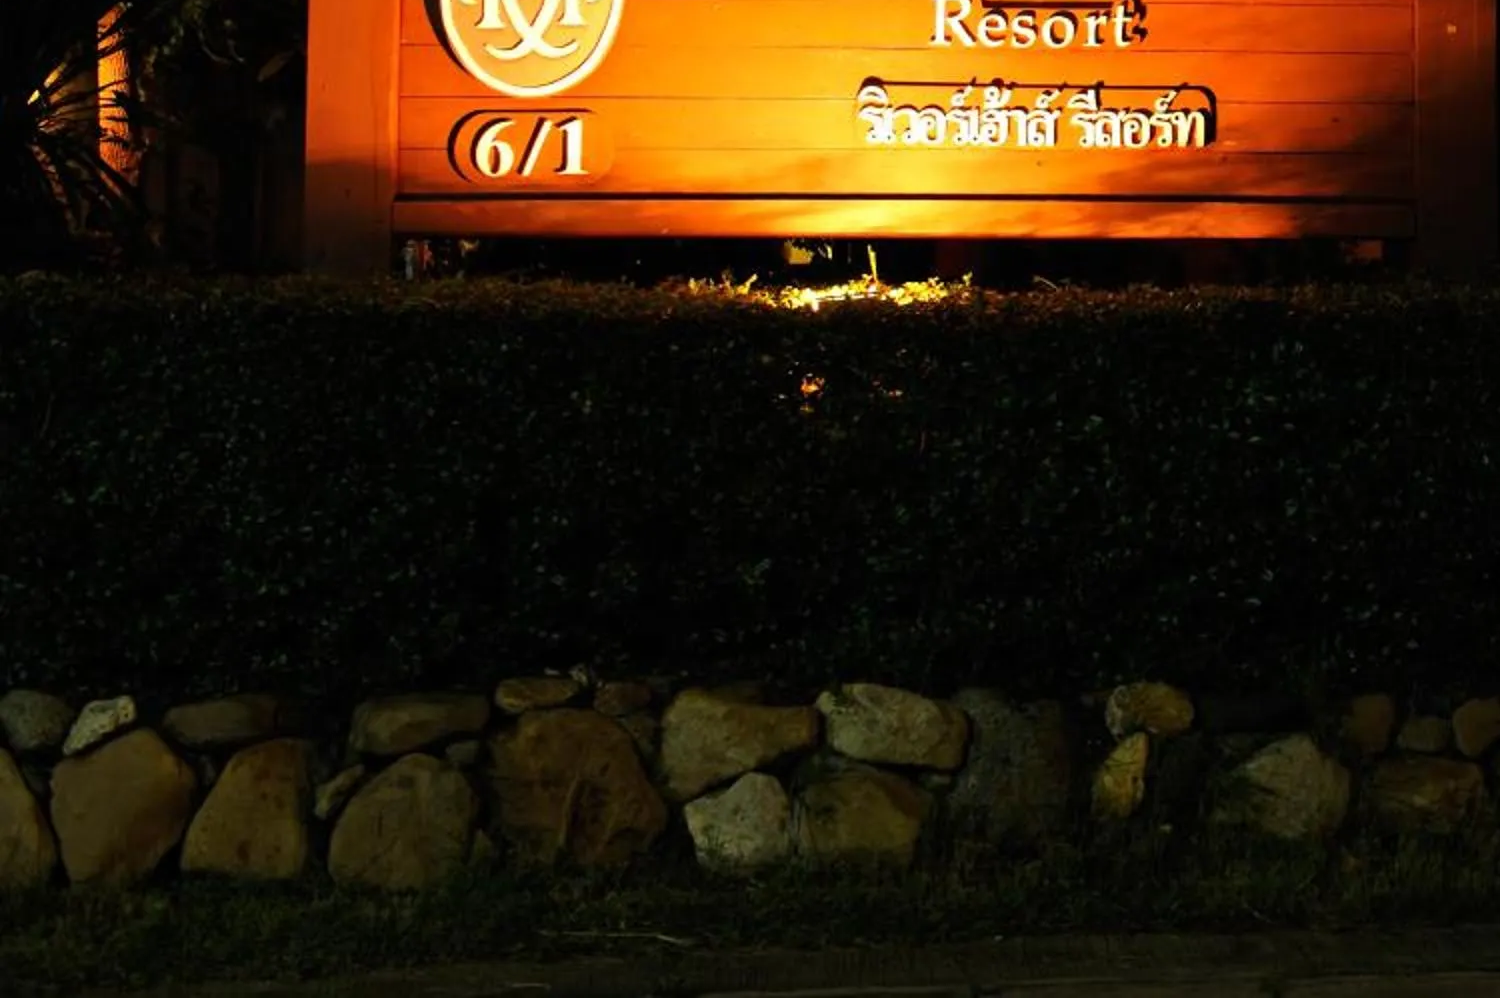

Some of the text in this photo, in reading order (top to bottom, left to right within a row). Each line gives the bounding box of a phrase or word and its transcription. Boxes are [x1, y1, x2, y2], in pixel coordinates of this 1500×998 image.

[475, 117, 591, 178] 6/1
[1067, 88, 1206, 148] รีสอร์ท
